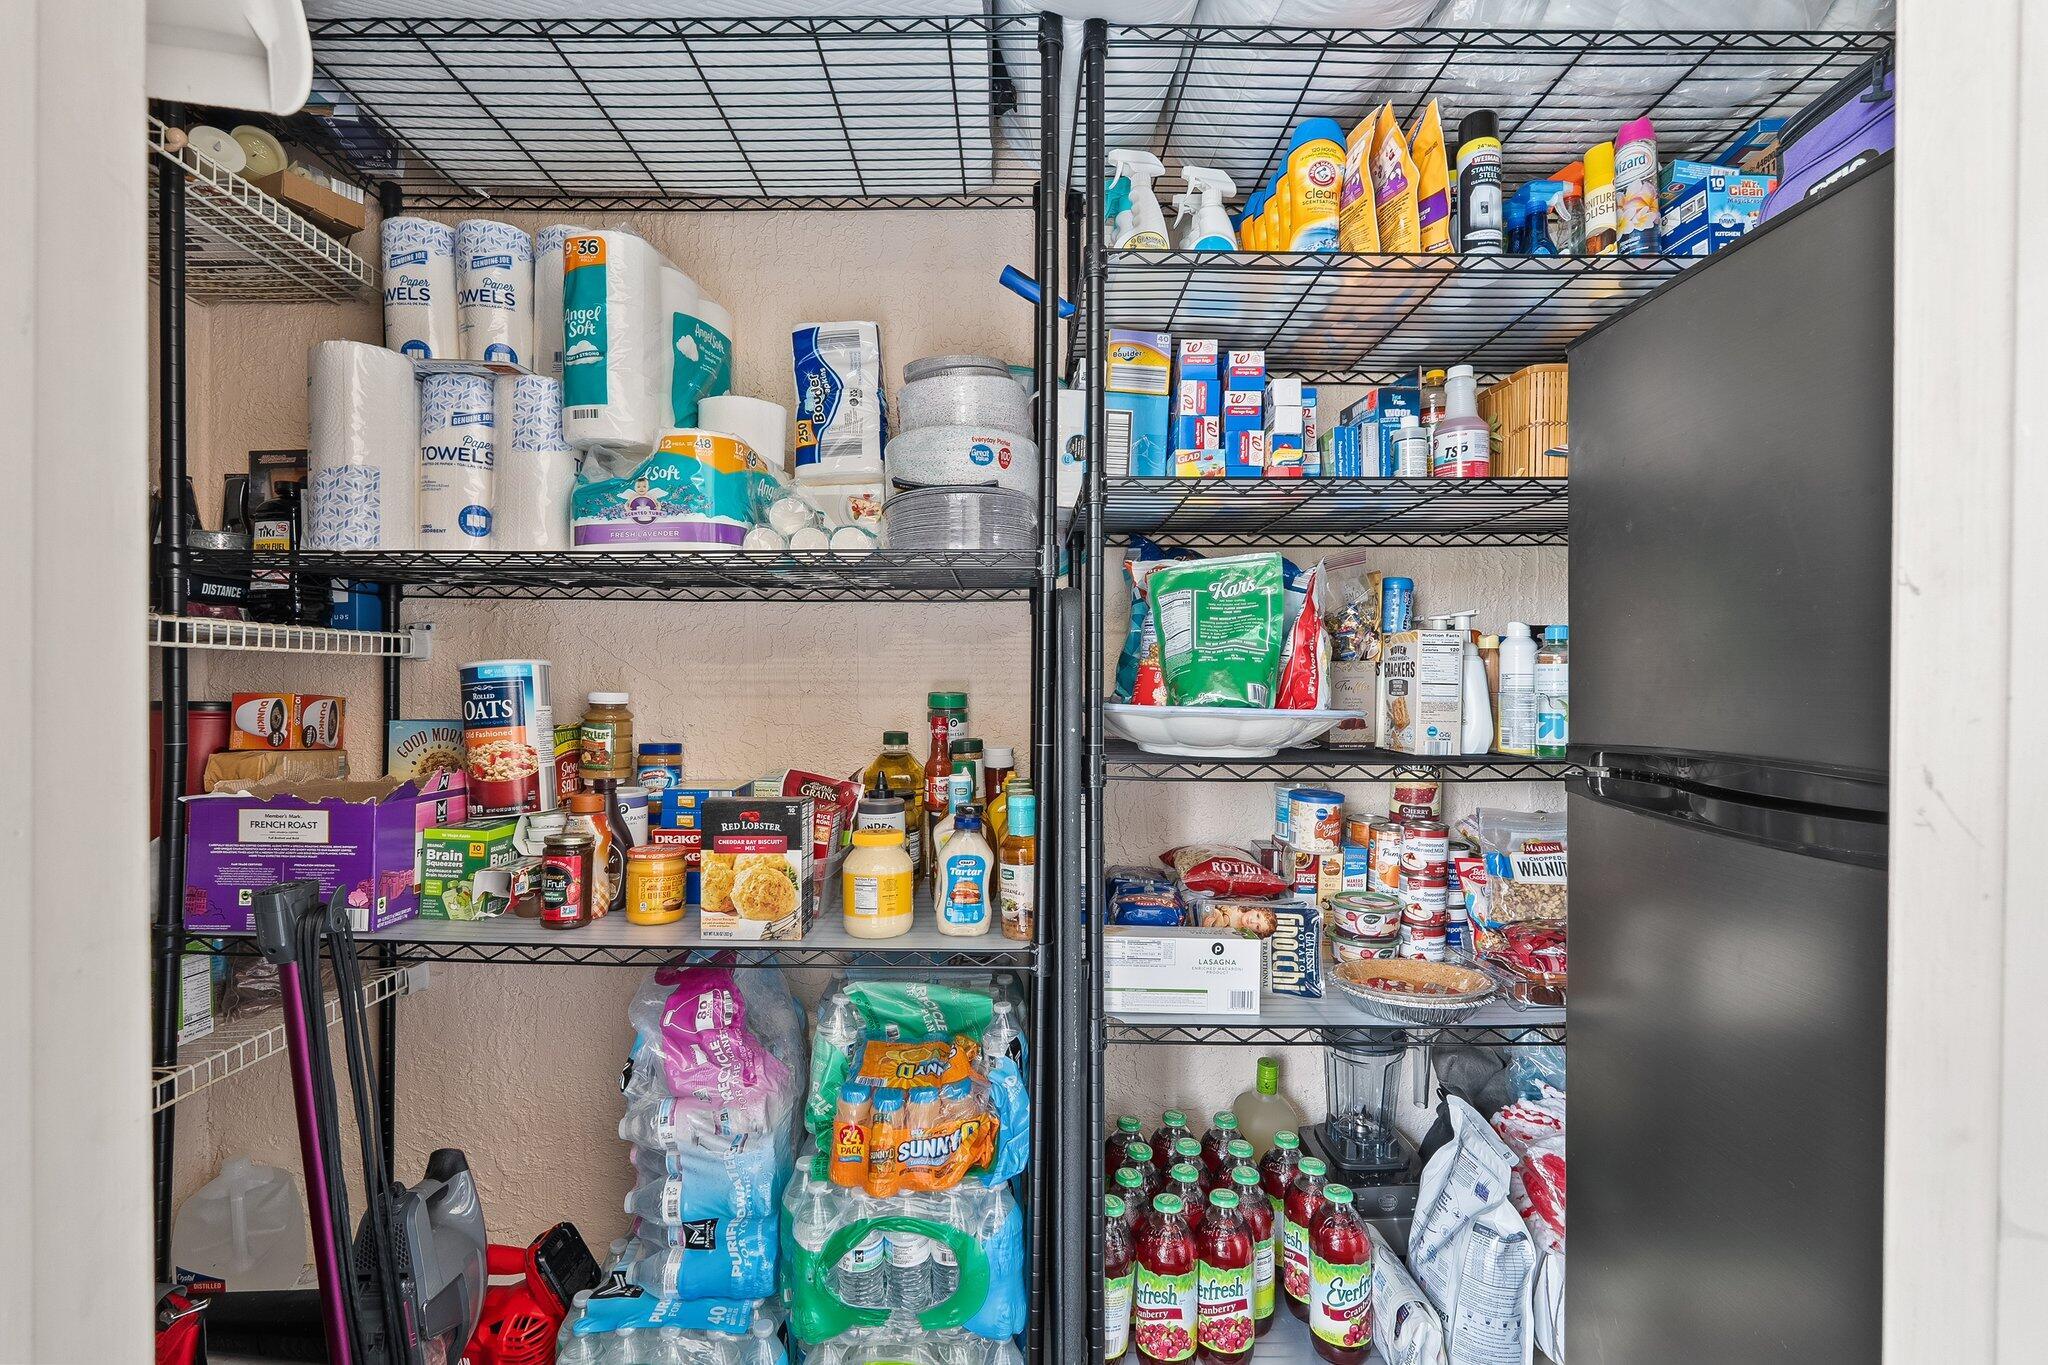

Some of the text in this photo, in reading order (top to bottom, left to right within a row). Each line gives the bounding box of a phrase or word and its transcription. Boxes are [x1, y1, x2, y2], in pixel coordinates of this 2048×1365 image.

[1479, 171, 1498, 179] STEEL
[1711, 177, 1725, 188] 10
[1741, 179, 1760, 188] Mr.
[1305, 188, 1339, 200] clean
[1729, 186, 1764, 197] Clean
[577, 240, 599, 255] 36
[414, 251, 427, 261] JOE
[400, 274, 430, 288] Paper
[482, 277, 515, 293] Paper
[565, 305, 601, 323] Angel
[569, 320, 597, 338] Soft
[1157, 335, 1169, 343] 40
[1113, 349, 1143, 358] Boulder
[453, 413, 482, 425] GENUINE
[798, 422, 809, 444] 250
[971, 448, 990, 457] Great
[1178, 451, 1200, 464] GLAD
[1445, 444, 1469, 459] TSP
[650, 464, 680, 481] Soft
[637, 530, 680, 538] LAVENDER
[201, 583, 242, 598] DISTANCE
[1308, 652, 1316, 686] FLAVOR
[1384, 661, 1416, 678] CRACKERS
[464, 700, 513, 721] OATS
[257, 700, 270, 736] DUNKIN'
[318, 702, 328, 743] DUNKIN'
[475, 729, 513, 738] Fashioned
[595, 730, 610, 740] LEAF
[396, 730, 428, 758] GOOD
[561, 779, 579, 793] SALT
[800, 784, 837, 802] GRAINS
[1402, 806, 1429, 815] CHERRY
[816, 813, 831, 821] RICE
[250, 820, 318, 830] FRENCH ROAST
[721, 820, 782, 832] RED LOBSTER
[473, 844, 482, 852] 10
[1418, 840, 1445, 848] Sweetened
[426, 849, 463, 861] Brain
[426, 860, 463, 868] Squeezers
[1211, 861, 1262, 875] ROTINI
[949, 866, 983, 877] Tartar
[547, 879, 567, 888] Fruit
[1296, 876, 1317, 884] JACK
[1298, 927, 1306, 972] POTATO
[1199, 958, 1238, 966] LASAGNA
[709, 1039, 735, 1103] RECYCLE
[735, 1090, 747, 1110] FOR
[840, 1128, 862, 1145] 24
[897, 1121, 981, 1163] SUNNYD
[840, 1145, 862, 1155] PACK
[193, 1282, 222, 1290] DISTILLED
